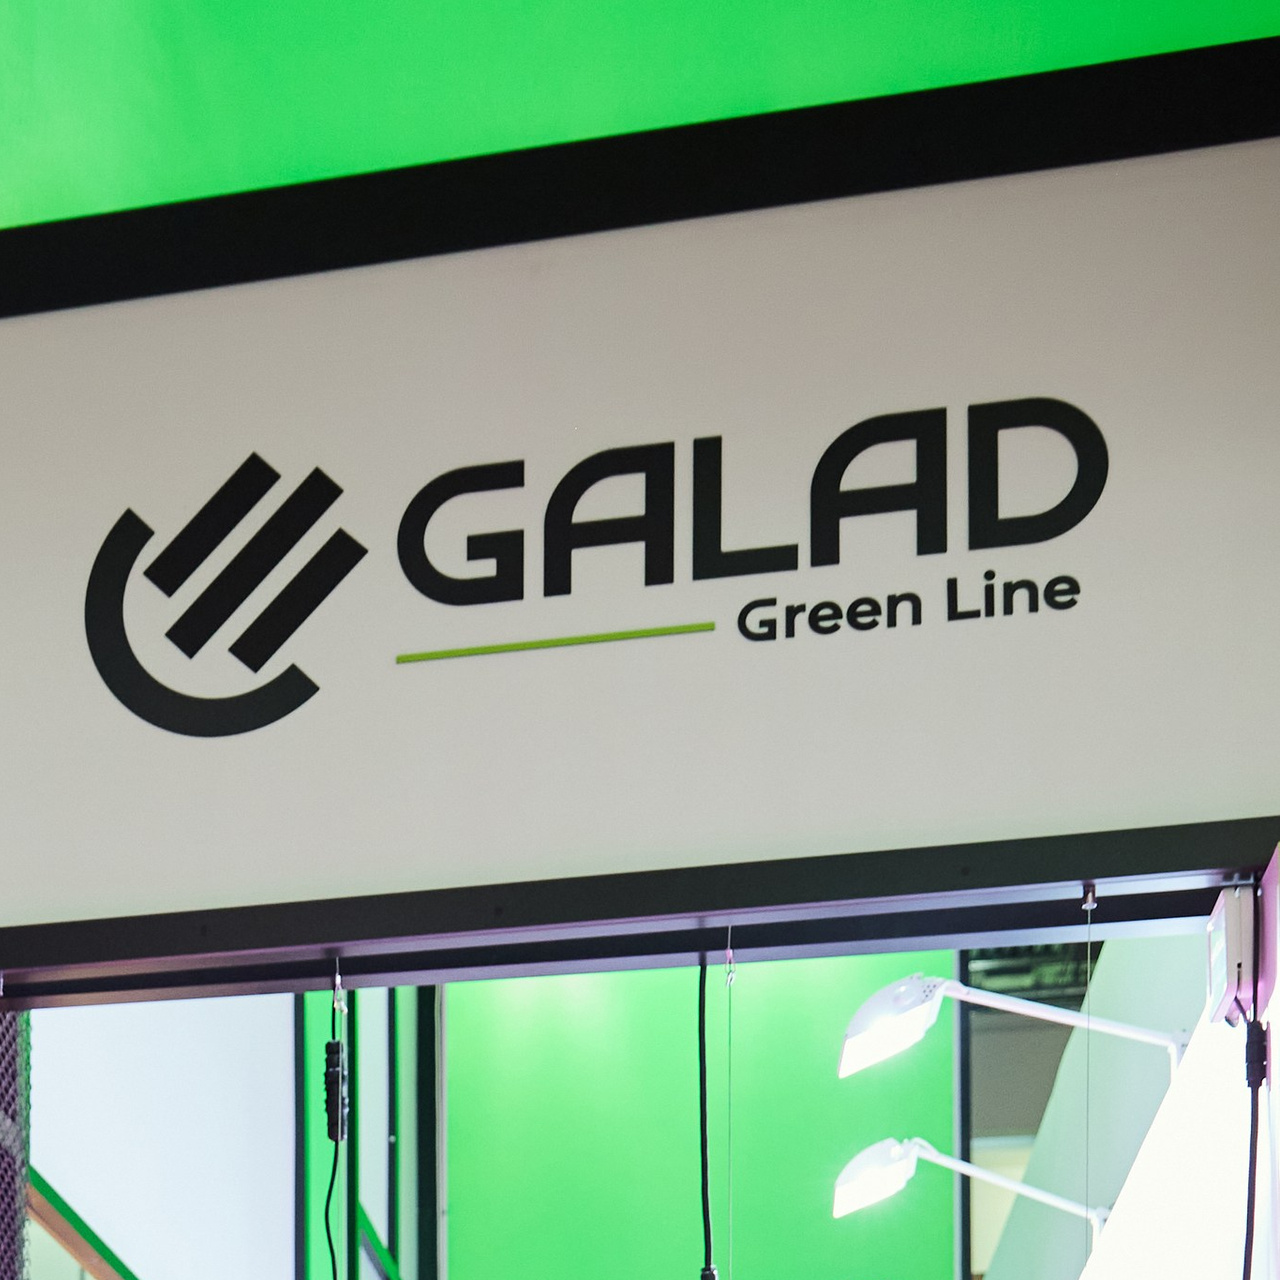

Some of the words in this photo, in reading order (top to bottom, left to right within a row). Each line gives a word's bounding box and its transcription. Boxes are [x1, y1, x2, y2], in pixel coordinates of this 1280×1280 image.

[397, 397, 1108, 606] GALAD
[737, 587, 923, 643] Green
[946, 570, 1081, 622] Line
